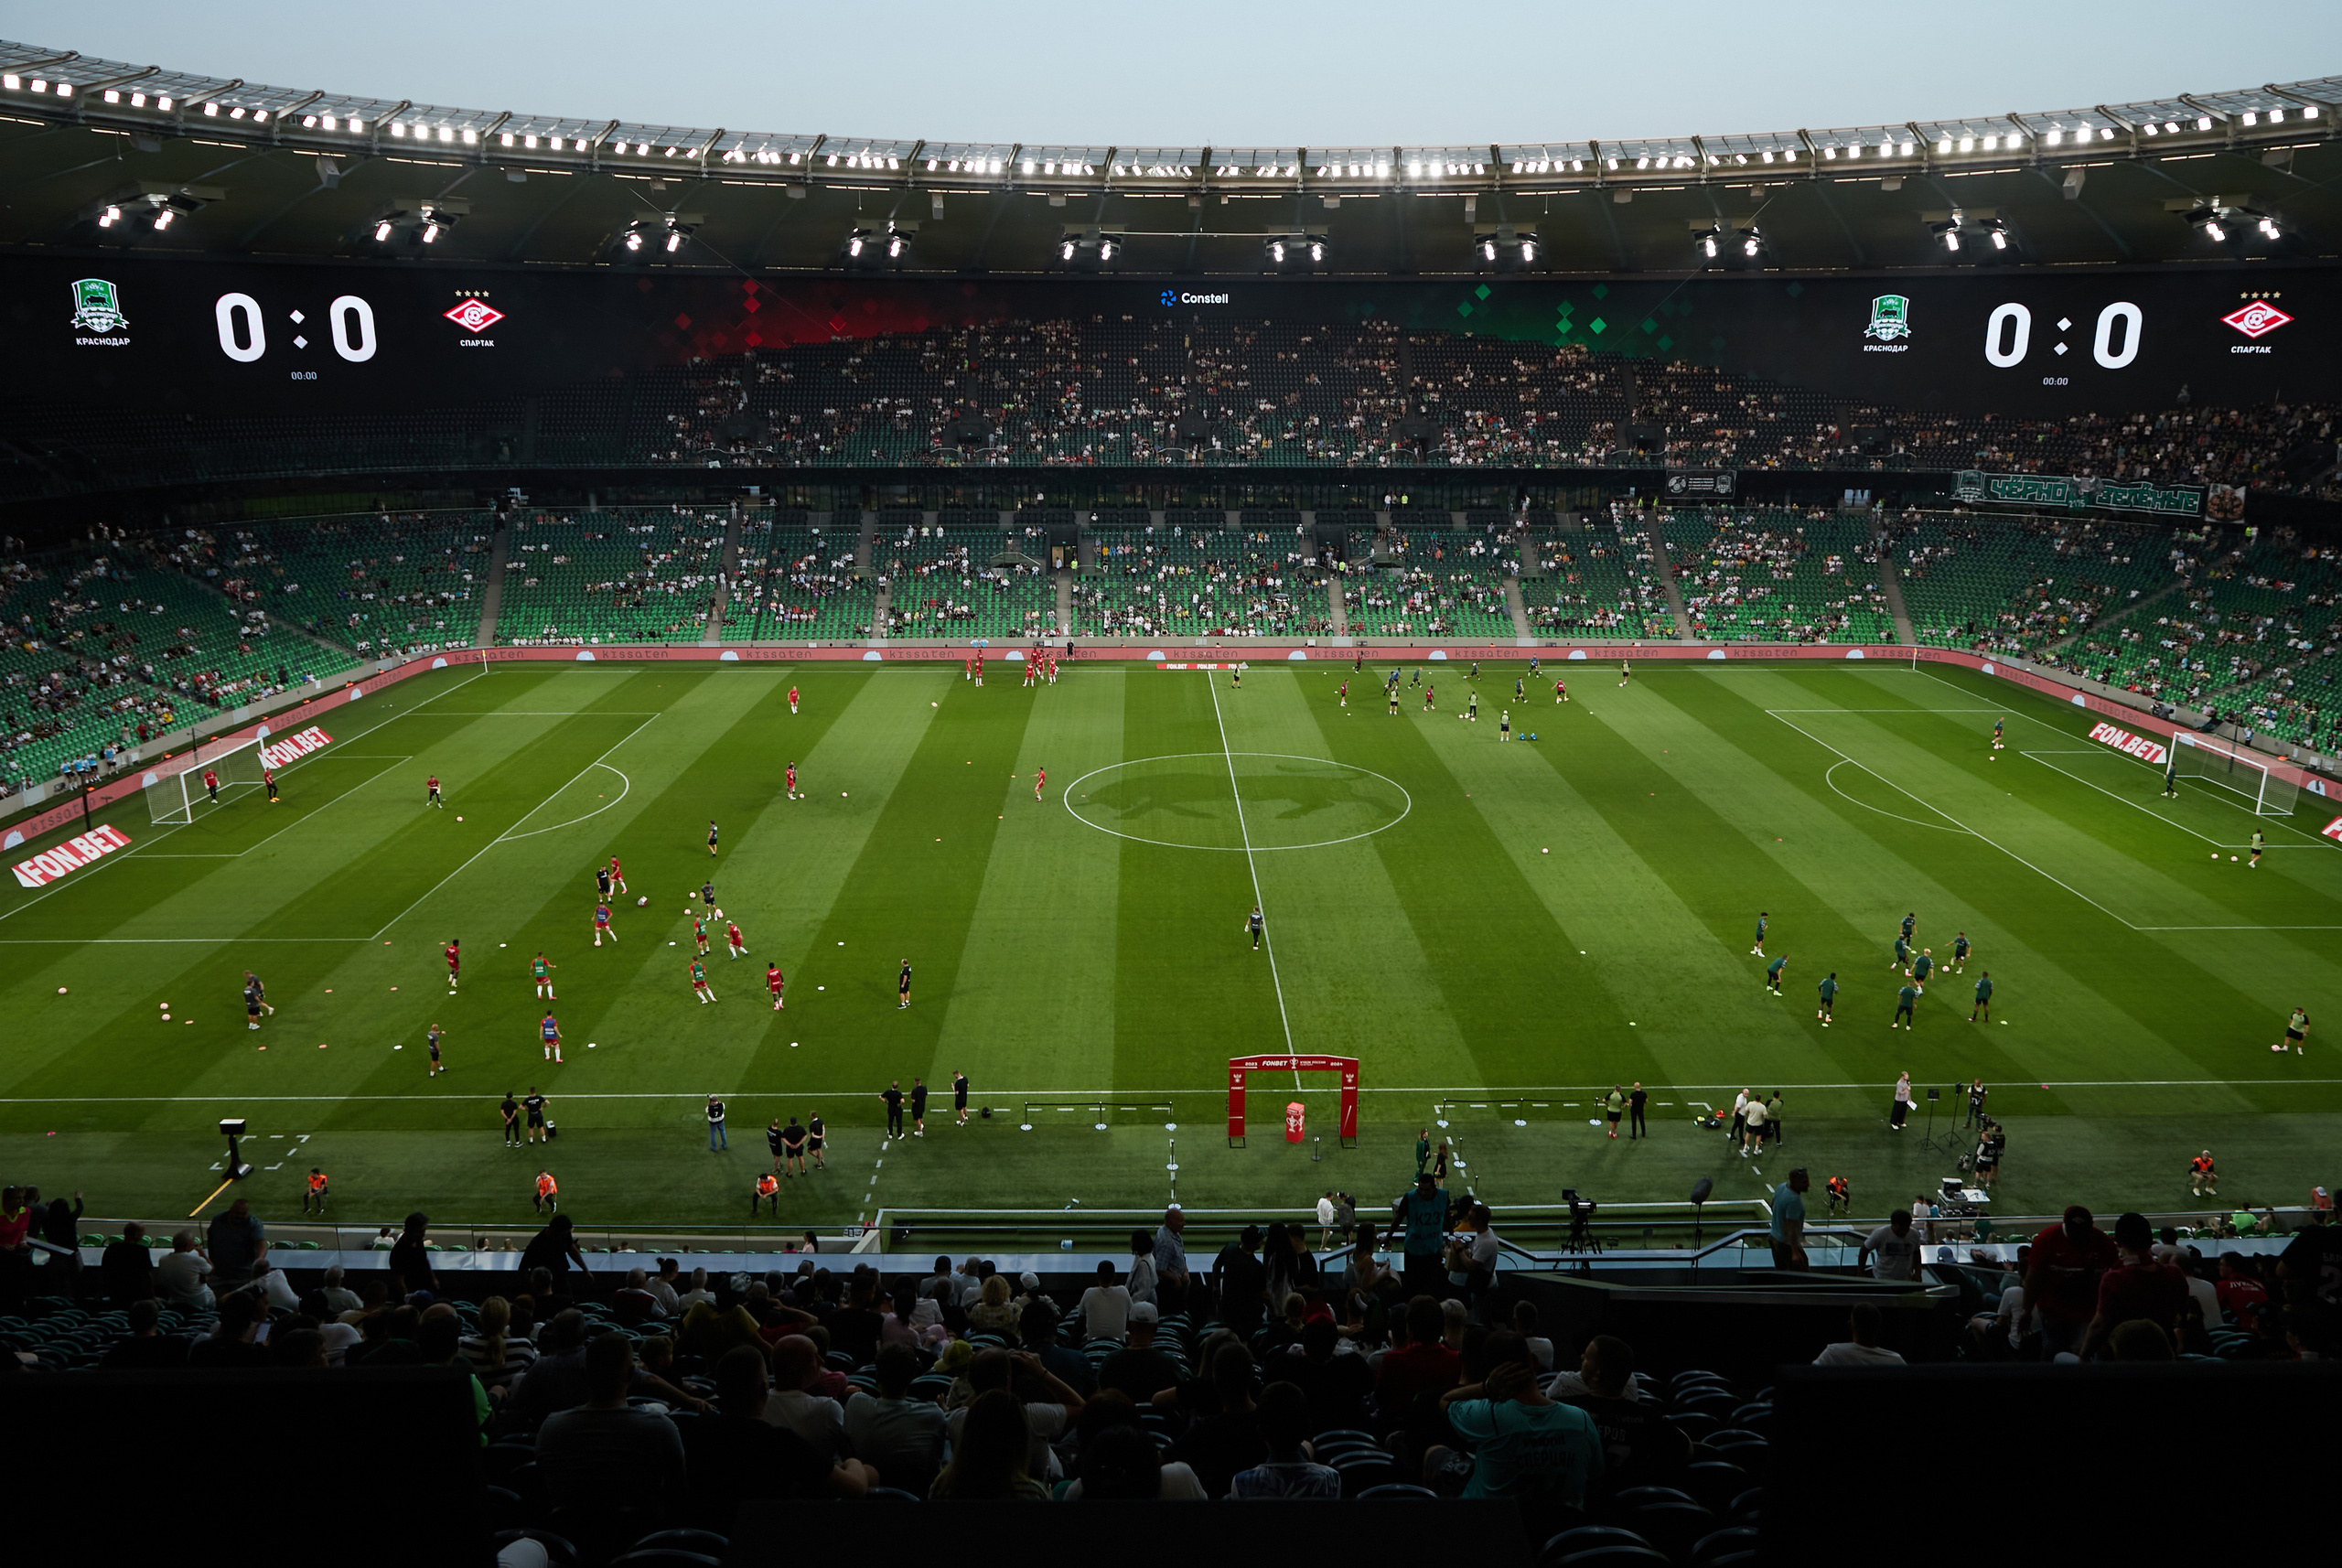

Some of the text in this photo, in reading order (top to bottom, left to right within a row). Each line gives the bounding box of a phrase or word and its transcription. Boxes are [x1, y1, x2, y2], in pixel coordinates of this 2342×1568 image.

[1181, 292, 1229, 304] Constell
[75, 338, 131, 347] КРАСНОДАР
[1863, 344, 1908, 353] КРАСНОДАР
[2230, 346, 2272, 354] СПАРТАК
[291, 371, 317, 381] 00:00
[2043, 376, 2069, 386] 00:00
[602, 649, 669, 660] kissaten
[746, 649, 812, 660] kissaten
[889, 649, 955, 660] kissaten
[1174, 650, 1238, 659] kissaten
[1455, 649, 1519, 659] kissaten
[1595, 649, 1659, 658] kissaten
[1734, 648, 1798, 658] kissaten
[263, 725, 330, 768] FON.BET
[2089, 722, 2165, 761] FON.BET
[18, 824, 125, 886] FON.BET
